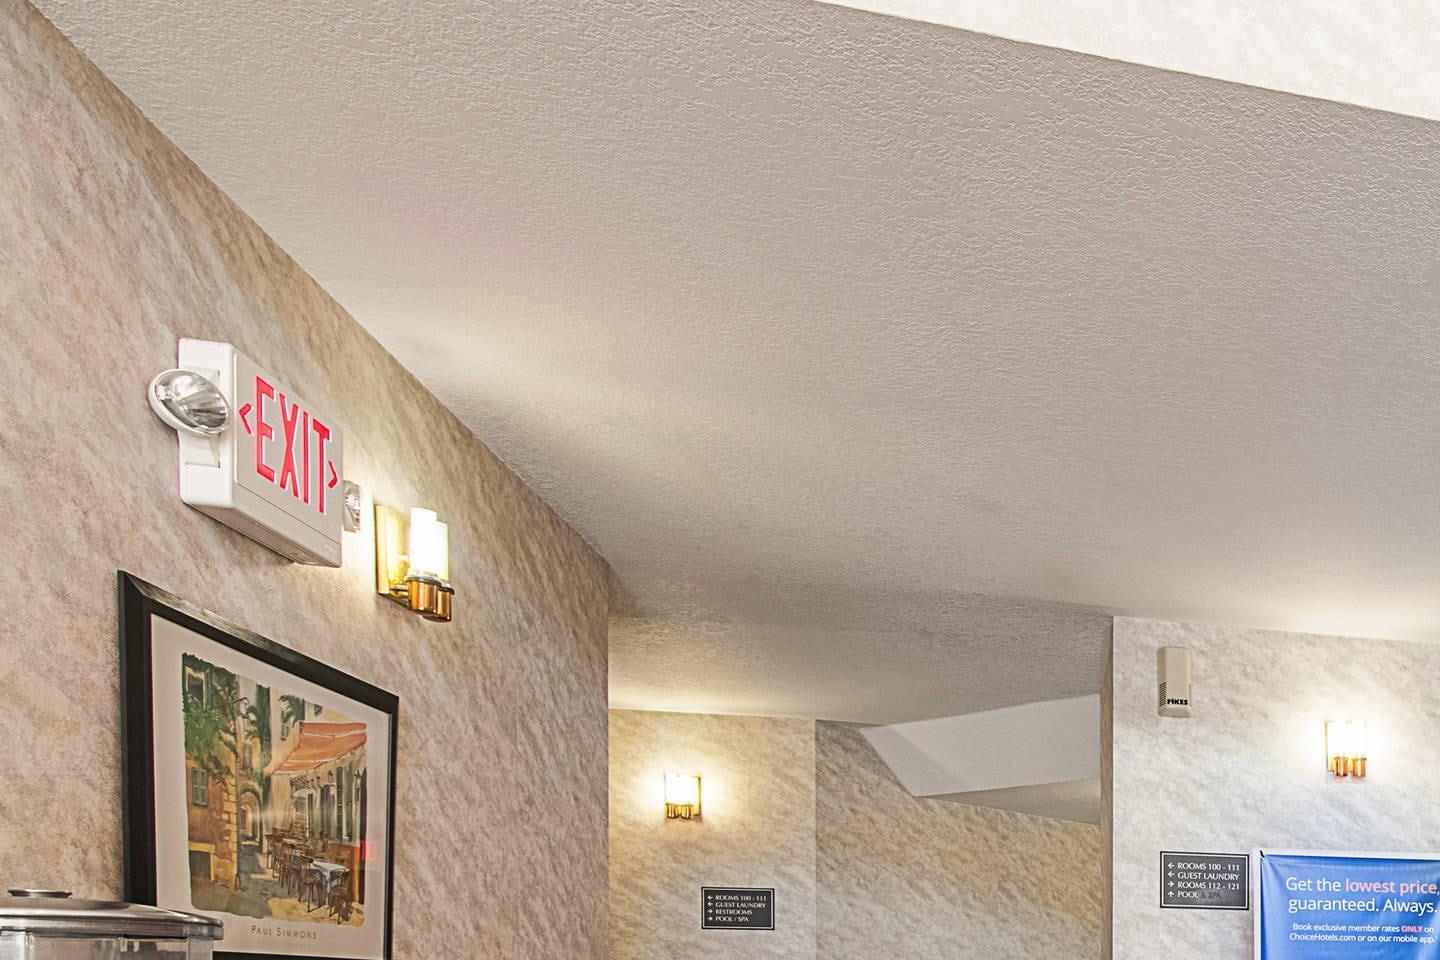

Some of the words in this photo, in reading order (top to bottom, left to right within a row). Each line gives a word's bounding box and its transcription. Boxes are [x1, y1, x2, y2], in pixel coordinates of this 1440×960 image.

[255, 375, 331, 514] EXIT
[1177, 862, 1206, 870] ROOMS
[1177, 872, 1202, 880] GUEST
[1204, 872, 1240, 880] LAUNDRY
[1286, 877, 1312, 892] Get
[1316, 878, 1341, 892] the
[1345, 878, 1396, 894] lowest
[1400, 880, 1440, 896] price,
[1288, 898, 1380, 913] guaranteed.
[1383, 899, 1438, 916] Always.
[250, 924, 272, 936] PAUL
[276, 927, 318, 940] SIMMONS
[1292, 923, 1312, 931] Book
[1314, 924, 1347, 932] exclusive
[1348, 924, 1380, 932] member
[1289, 933, 1356, 942] ChoiceHotels.com
[1392, 934, 1418, 942] mobile
